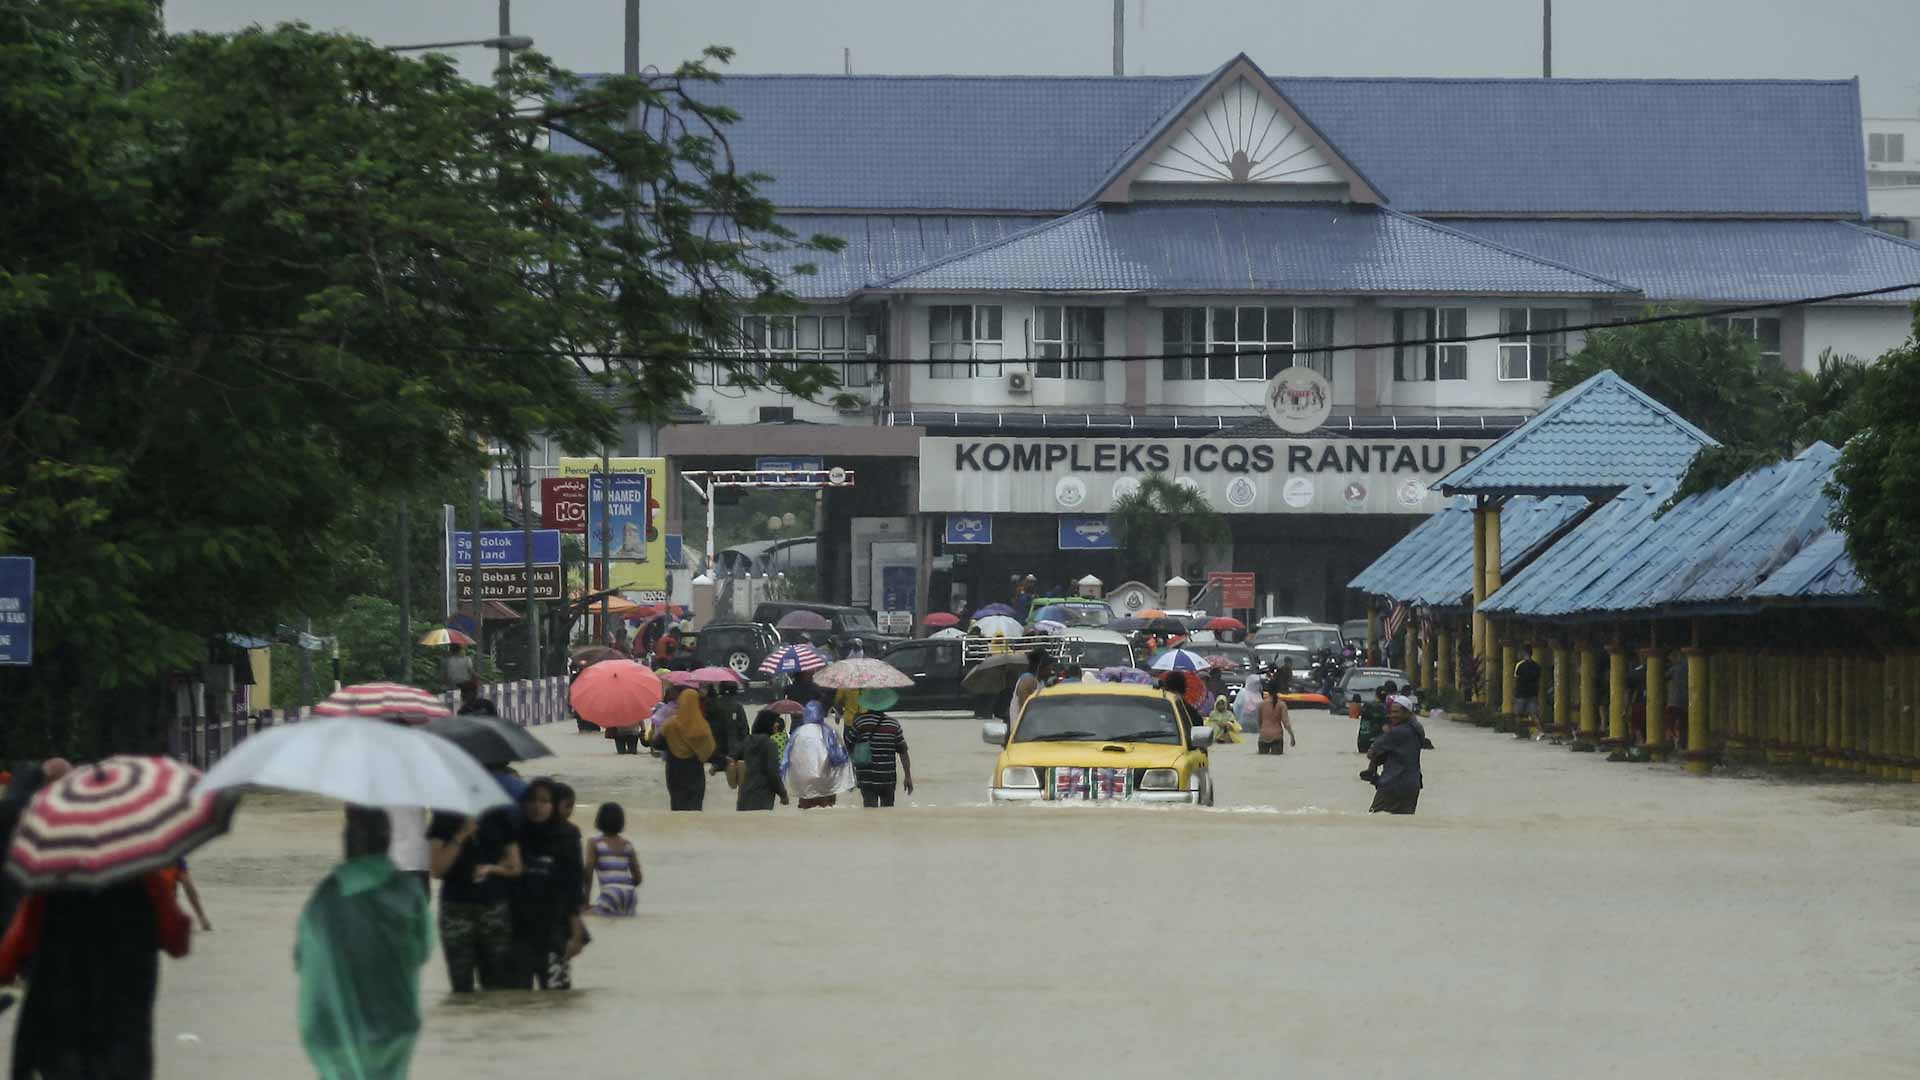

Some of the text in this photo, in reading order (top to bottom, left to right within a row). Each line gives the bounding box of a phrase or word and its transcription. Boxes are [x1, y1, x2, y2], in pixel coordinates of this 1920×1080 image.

[956, 443, 1169, 472] KOMPLEKS
[1184, 444, 1274, 474] ICQS
[1288, 445, 1445, 473] RANTAU
[480, 537, 512, 547] Golok
[457, 550, 506, 560] Thland
[483, 572, 516, 581] Bebas
